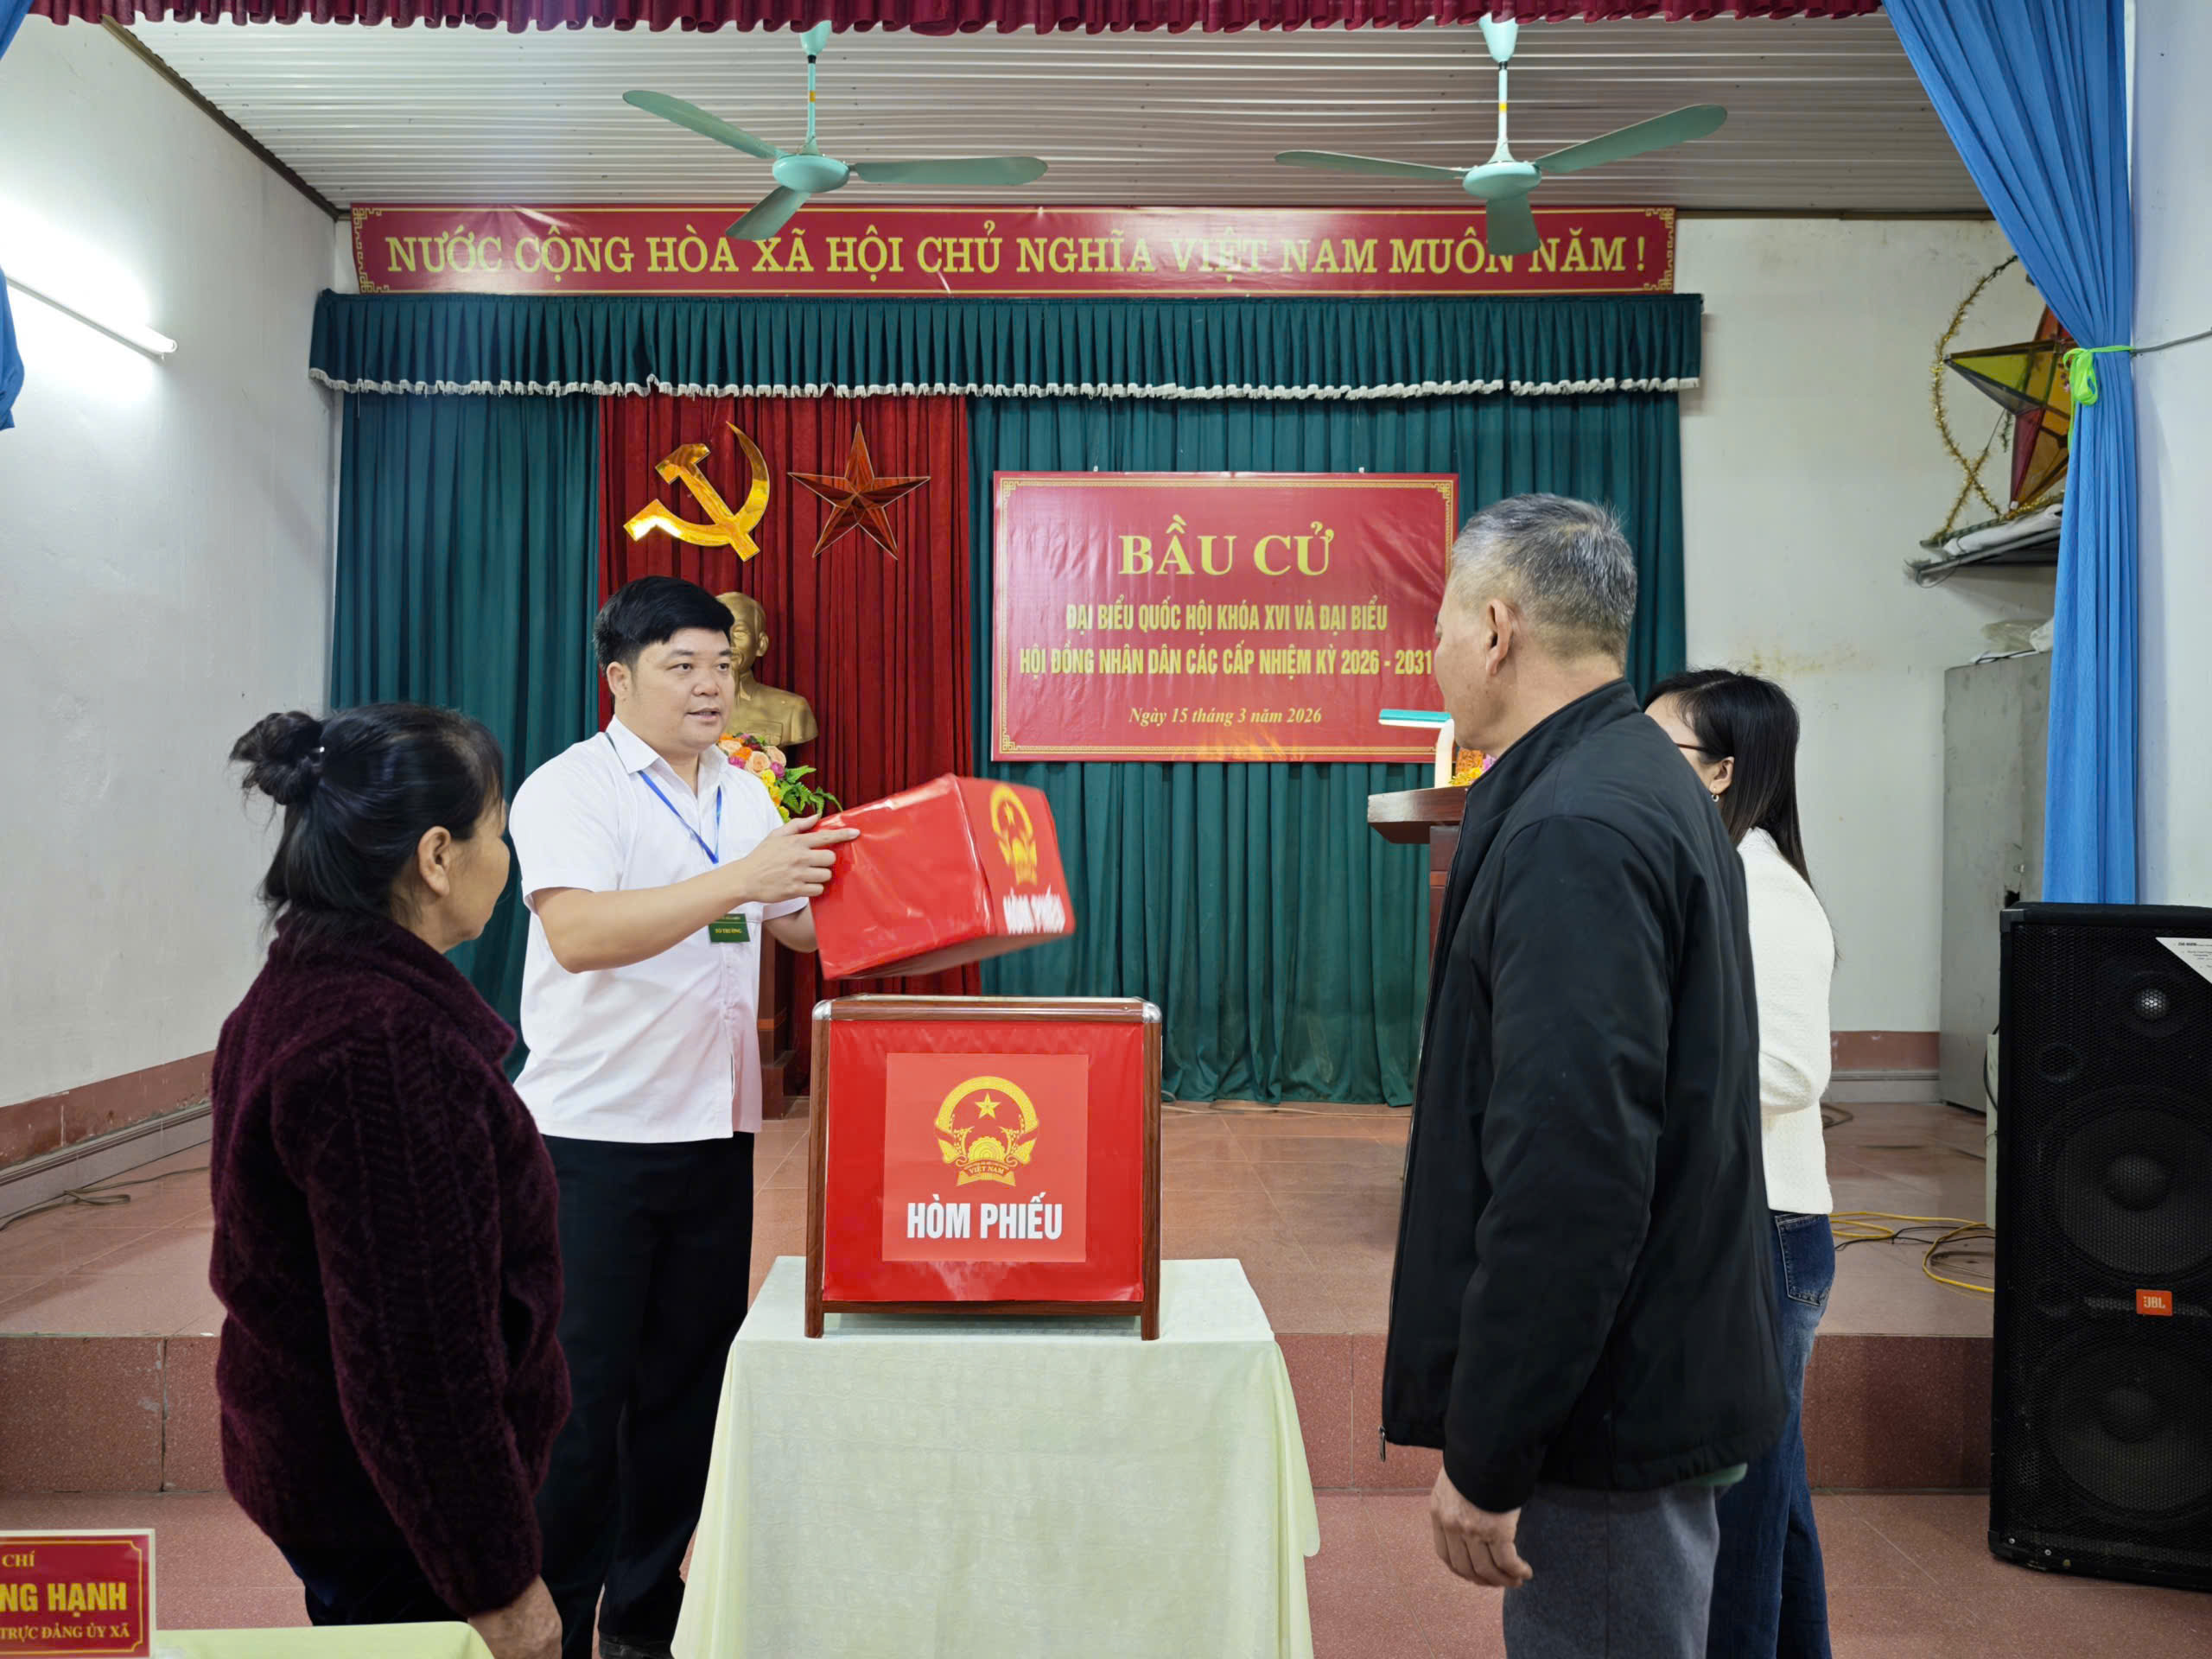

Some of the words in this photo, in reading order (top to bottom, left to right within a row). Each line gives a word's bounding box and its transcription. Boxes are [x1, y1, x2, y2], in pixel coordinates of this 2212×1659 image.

[385, 225, 502, 272] NƯỚC
[515, 225, 634, 283] CỘNG
[645, 224, 739, 272] HÒA
[752, 227, 814, 272] XÃ
[826, 225, 904, 283] HỘI
[917, 219, 1002, 273] CHỦ
[1016, 229, 1155, 273] NGHĨA
[1170, 226, 1268, 283] VIỆT
[1279, 238, 1378, 273] NAM
[1528, 227, 1627, 272] NĂM
[1119, 514, 1237, 575] BẦU
[1253, 520, 1335, 576] CỬ
[1066, 604, 1093, 636] ĐẠI
[1097, 594, 1135, 630] BIỂU
[1138, 595, 1181, 633] QUỐC
[1185, 599, 1212, 636] HỘI
[1217, 599, 1260, 630] KHÓA
[1264, 605, 1291, 630] XVI
[1294, 600, 1316, 630] VÀ
[1319, 605, 1346, 636] ĐẠI
[1351, 594, 1388, 630] BIỂU
[1019, 644, 1046, 680] HỘI
[1051, 639, 1095, 674] ĐỒNG
[1098, 644, 1144, 674] NHÂN
[1147, 644, 1182, 674] DÂN
[1185, 644, 1218, 675] CÁC
[1223, 639, 1255, 675] CẤP
[1259, 644, 1312, 680] NHIỆM
[1315, 644, 1338, 674] KỲ
[1340, 649, 1380, 675] 2026
[1394, 649, 1433, 675] 2031
[1128, 708, 1167, 726] Ngày
[1172, 708, 1188, 723] 15
[1192, 707, 1234, 726] tháng
[1238, 708, 1247, 723] 3
[1250, 709, 1283, 723] năm
[1287, 708, 1322, 723] 2026
[907, 1193, 971, 1239] HÒM
[980, 1192, 1063, 1240] PHIẾU
[2143, 1296, 2166, 1309] JBL
[2, 1550, 35, 1567] CHÍ
[48, 1582, 127, 1618] HẠNH
[0, 1625, 39, 1642] TRỰC
[41, 1622, 83, 1638] ĐẢNG
[86, 1623, 106, 1637] ỦY
[111, 1622, 130, 1637] XÃ
